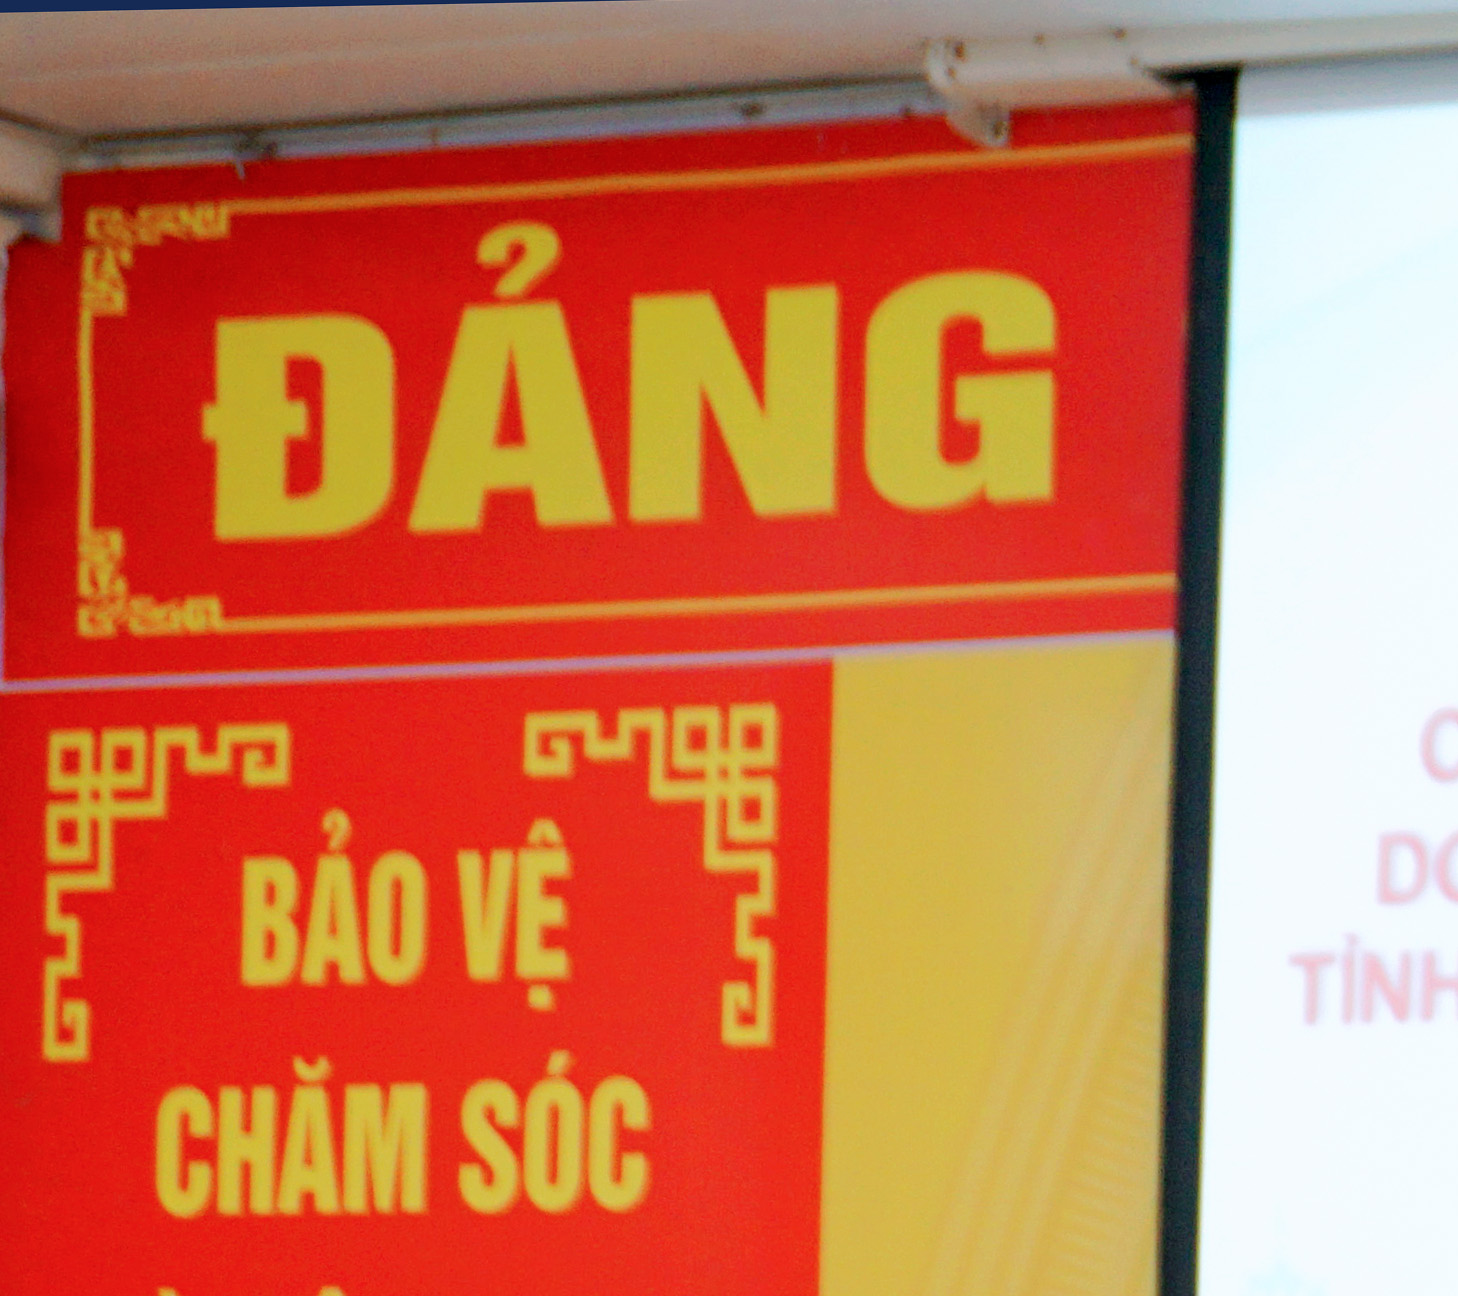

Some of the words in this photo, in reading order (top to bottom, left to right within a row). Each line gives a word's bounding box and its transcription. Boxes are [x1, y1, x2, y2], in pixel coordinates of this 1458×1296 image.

[204, 225, 1055, 539] ĐẢNG
[242, 810, 426, 986] BẢO
[458, 819, 570, 1010] VỆ
[156, 1058, 427, 1218] CHĂM
[459, 1051, 650, 1214] SÓC
